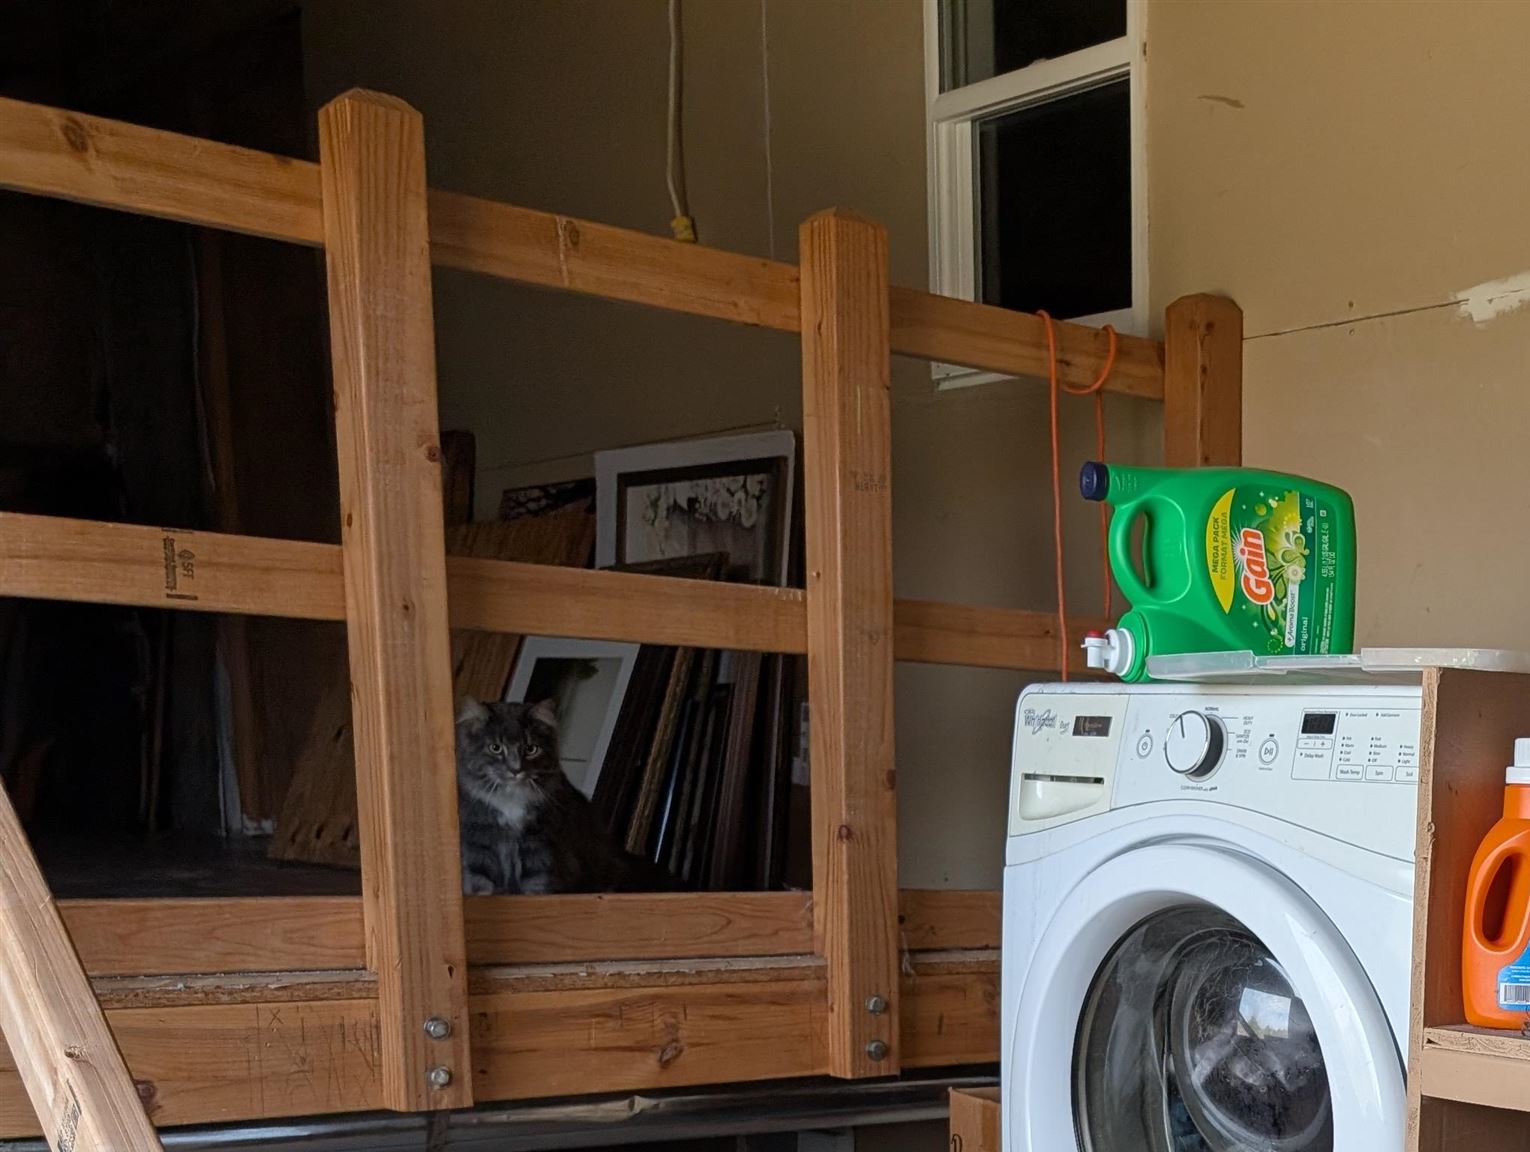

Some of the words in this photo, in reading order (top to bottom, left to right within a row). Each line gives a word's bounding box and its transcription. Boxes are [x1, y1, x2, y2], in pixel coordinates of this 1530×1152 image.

[1212, 516, 1220, 542] PACK
[1212, 545, 1220, 573] MEGA
[1220, 541, 1228, 581] FORMAT
[1240, 529, 1275, 604] Gain
[1300, 616, 1309, 652] original
